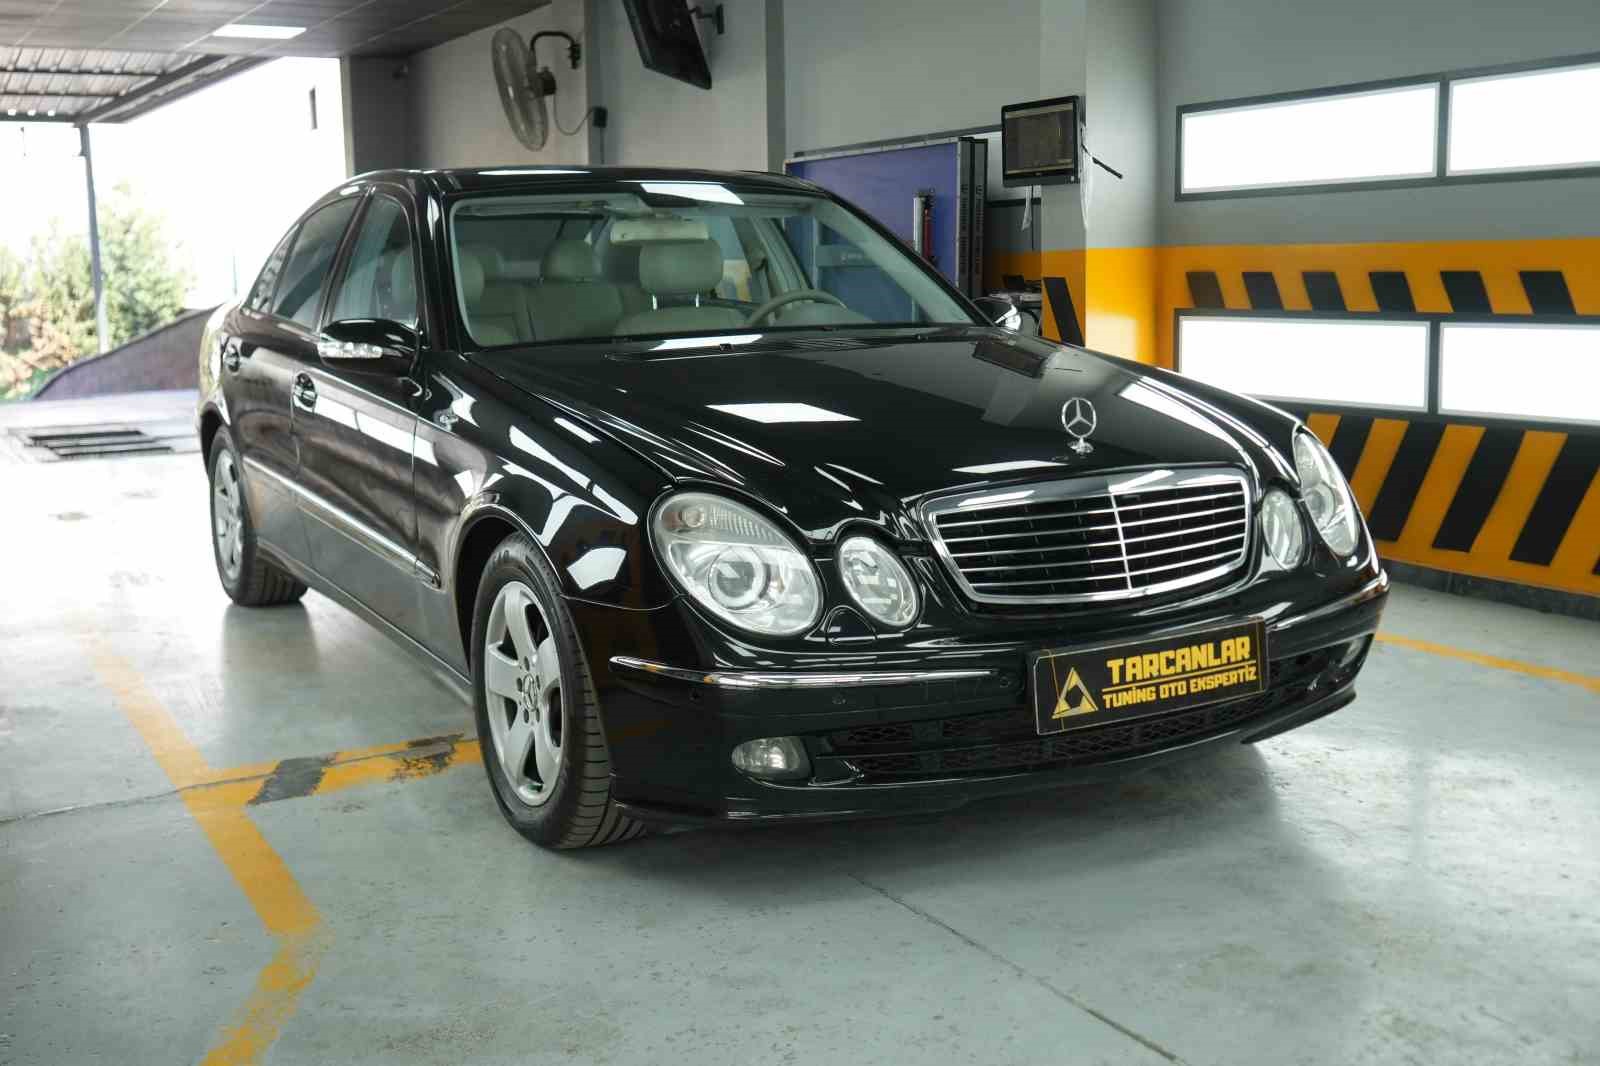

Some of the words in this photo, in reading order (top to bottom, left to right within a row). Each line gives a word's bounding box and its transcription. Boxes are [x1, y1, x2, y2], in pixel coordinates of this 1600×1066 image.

[1107, 636, 1250, 685] TARCANLAR
[1160, 680, 1187, 699] OTO
[1190, 665, 1257, 693] EKSPERTİZ
